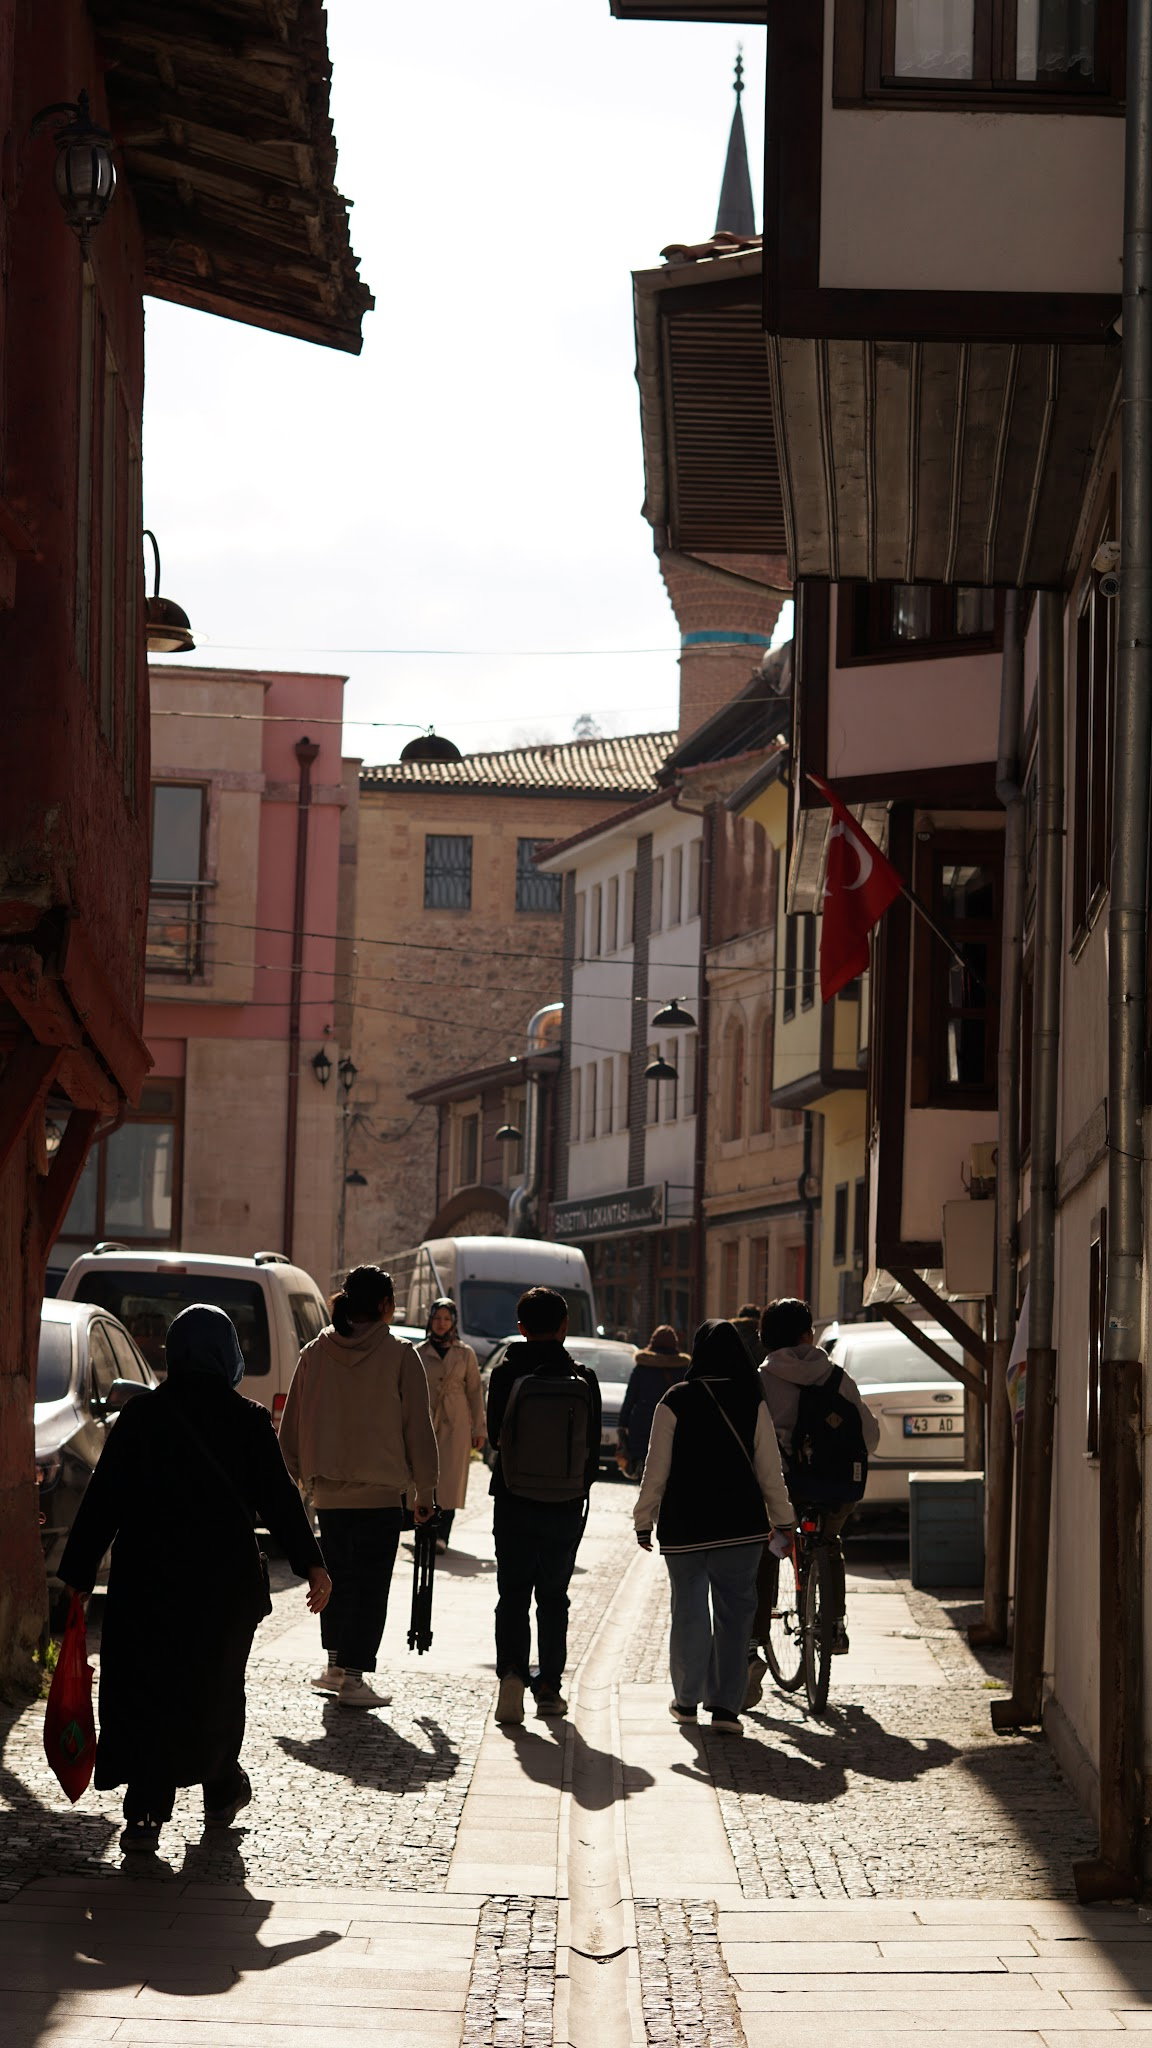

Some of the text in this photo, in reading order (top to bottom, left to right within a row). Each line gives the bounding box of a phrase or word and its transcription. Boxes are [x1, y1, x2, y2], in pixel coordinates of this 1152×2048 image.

[588, 1202, 630, 1228] LOKANTASI
[913, 1418, 953, 1431] 43 AD
